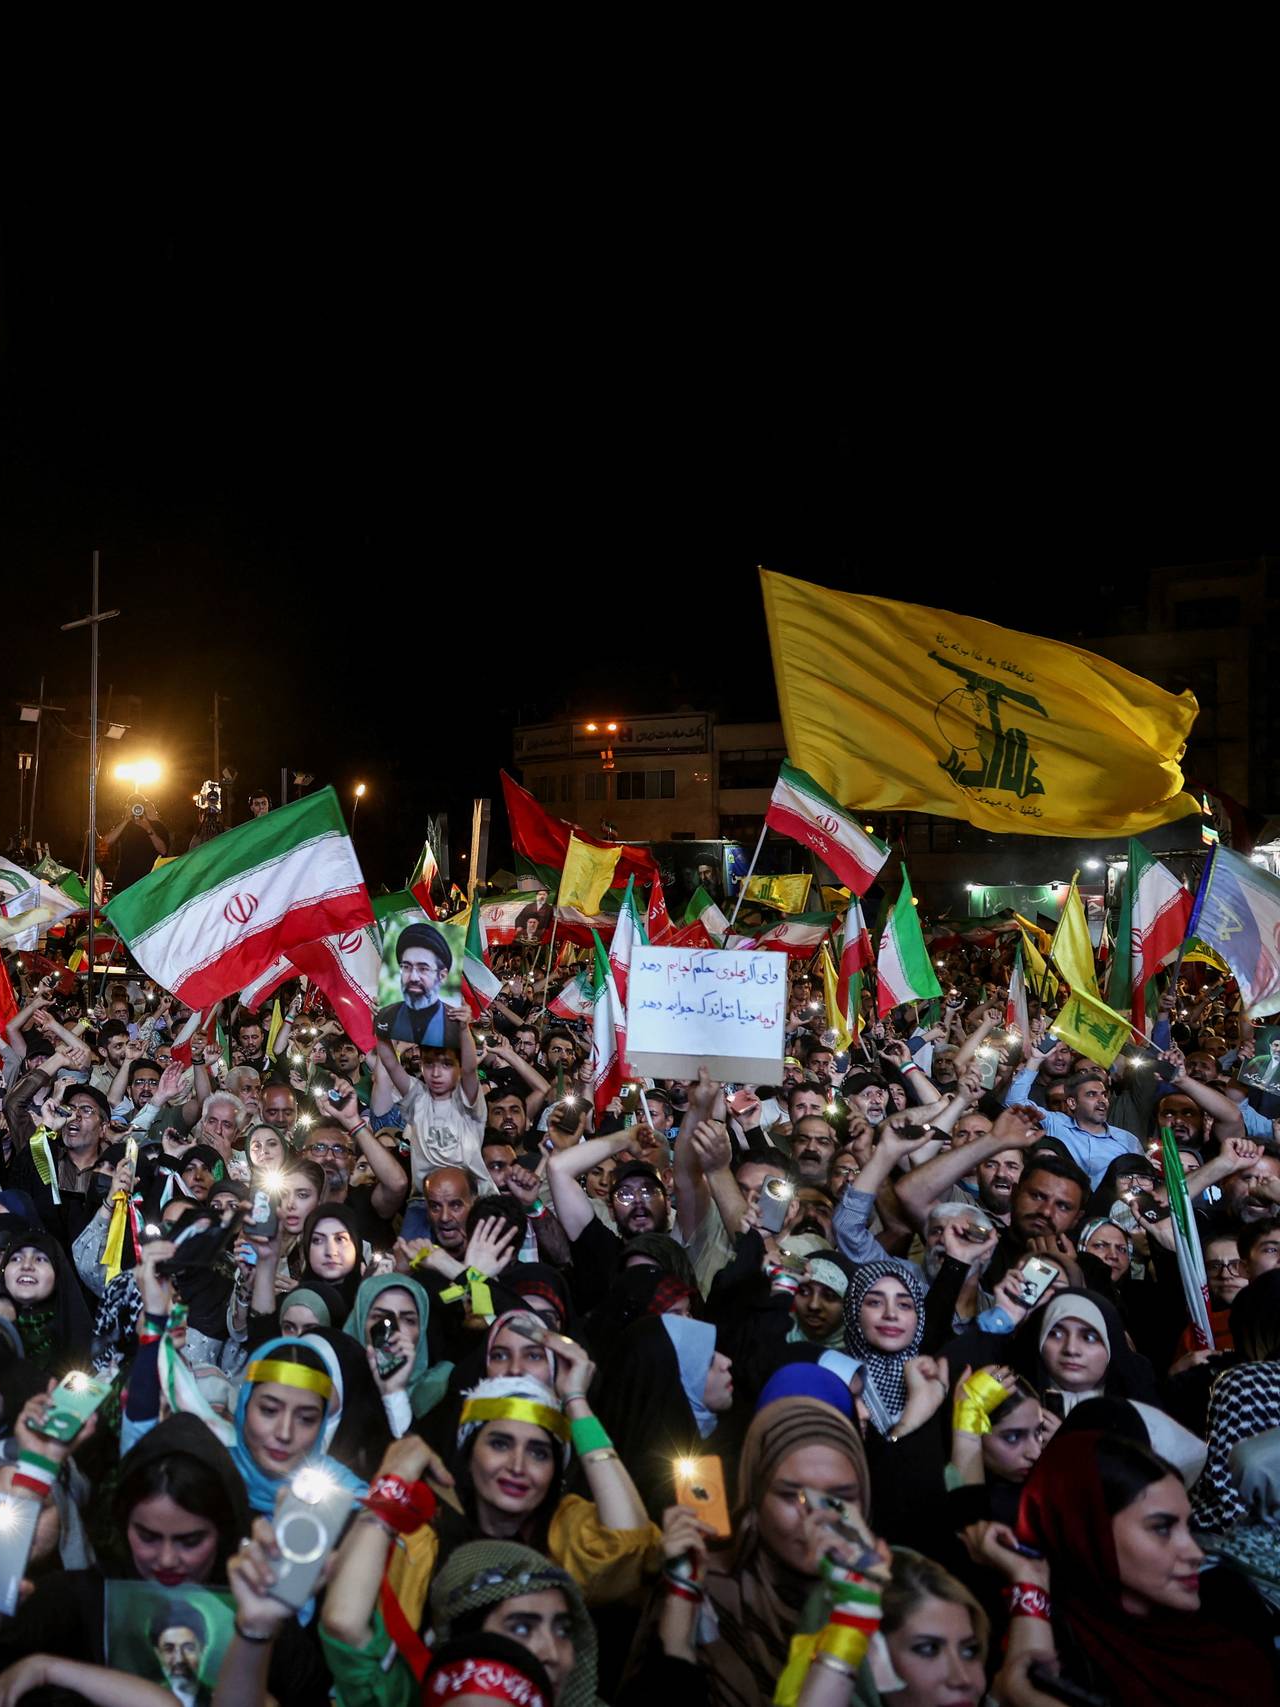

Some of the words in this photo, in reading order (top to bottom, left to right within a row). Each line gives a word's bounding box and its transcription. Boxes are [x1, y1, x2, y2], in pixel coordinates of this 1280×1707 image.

[639, 961, 663, 973] دهد
[692, 951, 719, 984] حکم
[756, 962, 779, 985] وای
[639, 1000, 663, 1010] دهد
[665, 991, 695, 1021] جوابم
[736, 999, 757, 1025] دنیا
